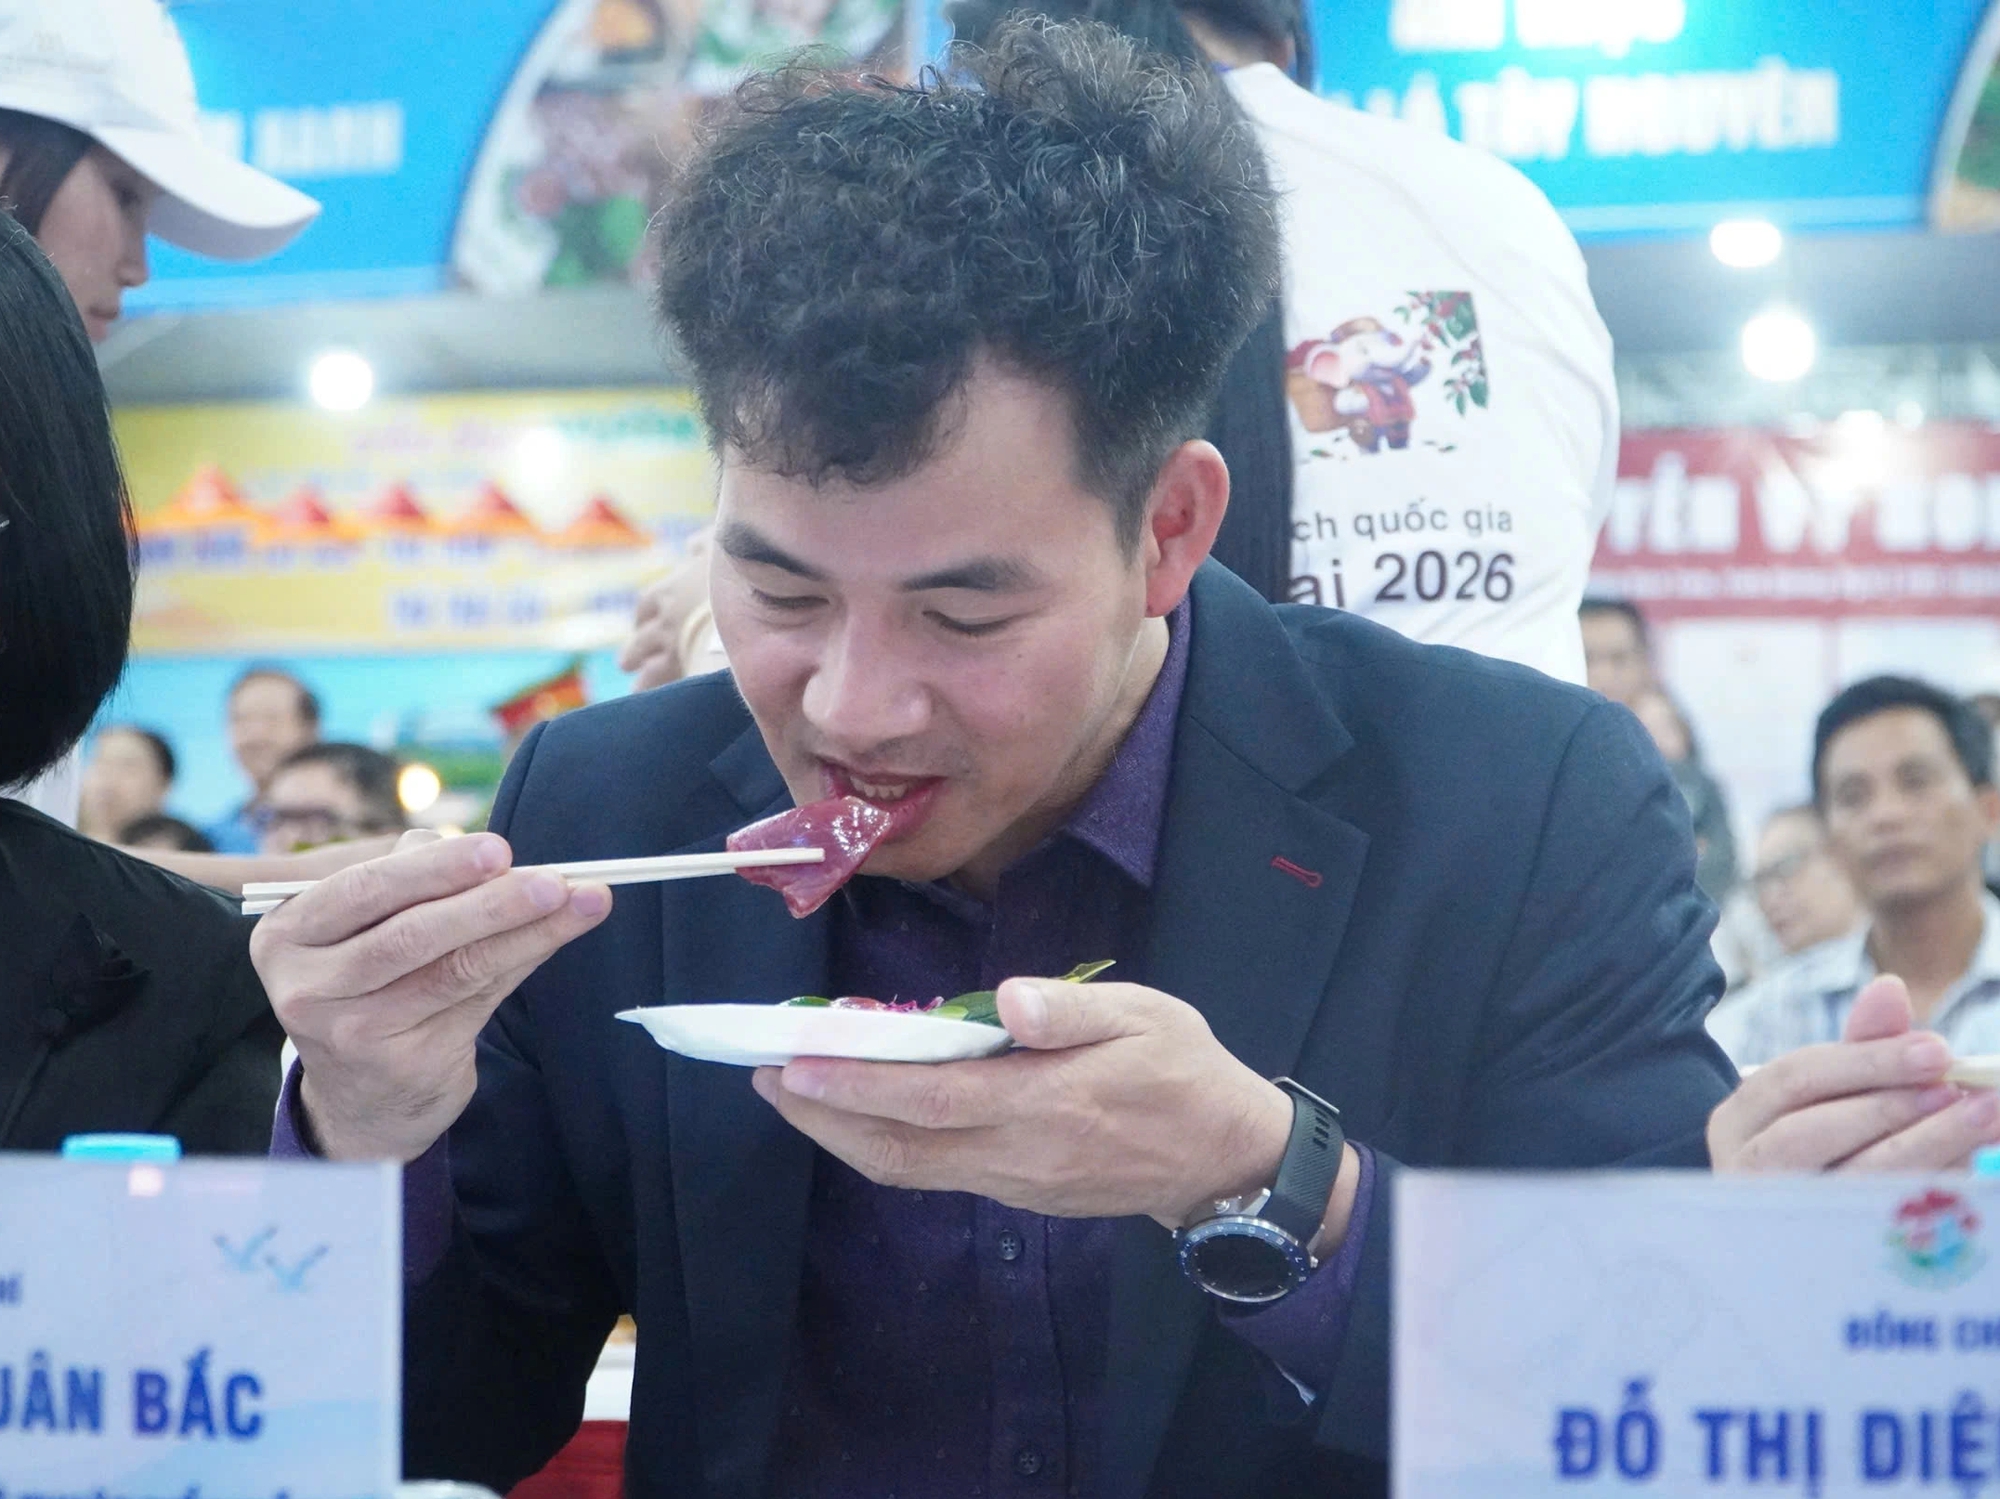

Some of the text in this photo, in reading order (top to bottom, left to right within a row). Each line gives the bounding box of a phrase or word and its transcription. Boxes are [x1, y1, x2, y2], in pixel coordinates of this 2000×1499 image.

[1353, 497, 1449, 542] quốc
[1462, 503, 1512, 537] gia
[1374, 550, 1515, 603] 2026
[133, 1346, 263, 1439] BẮC
